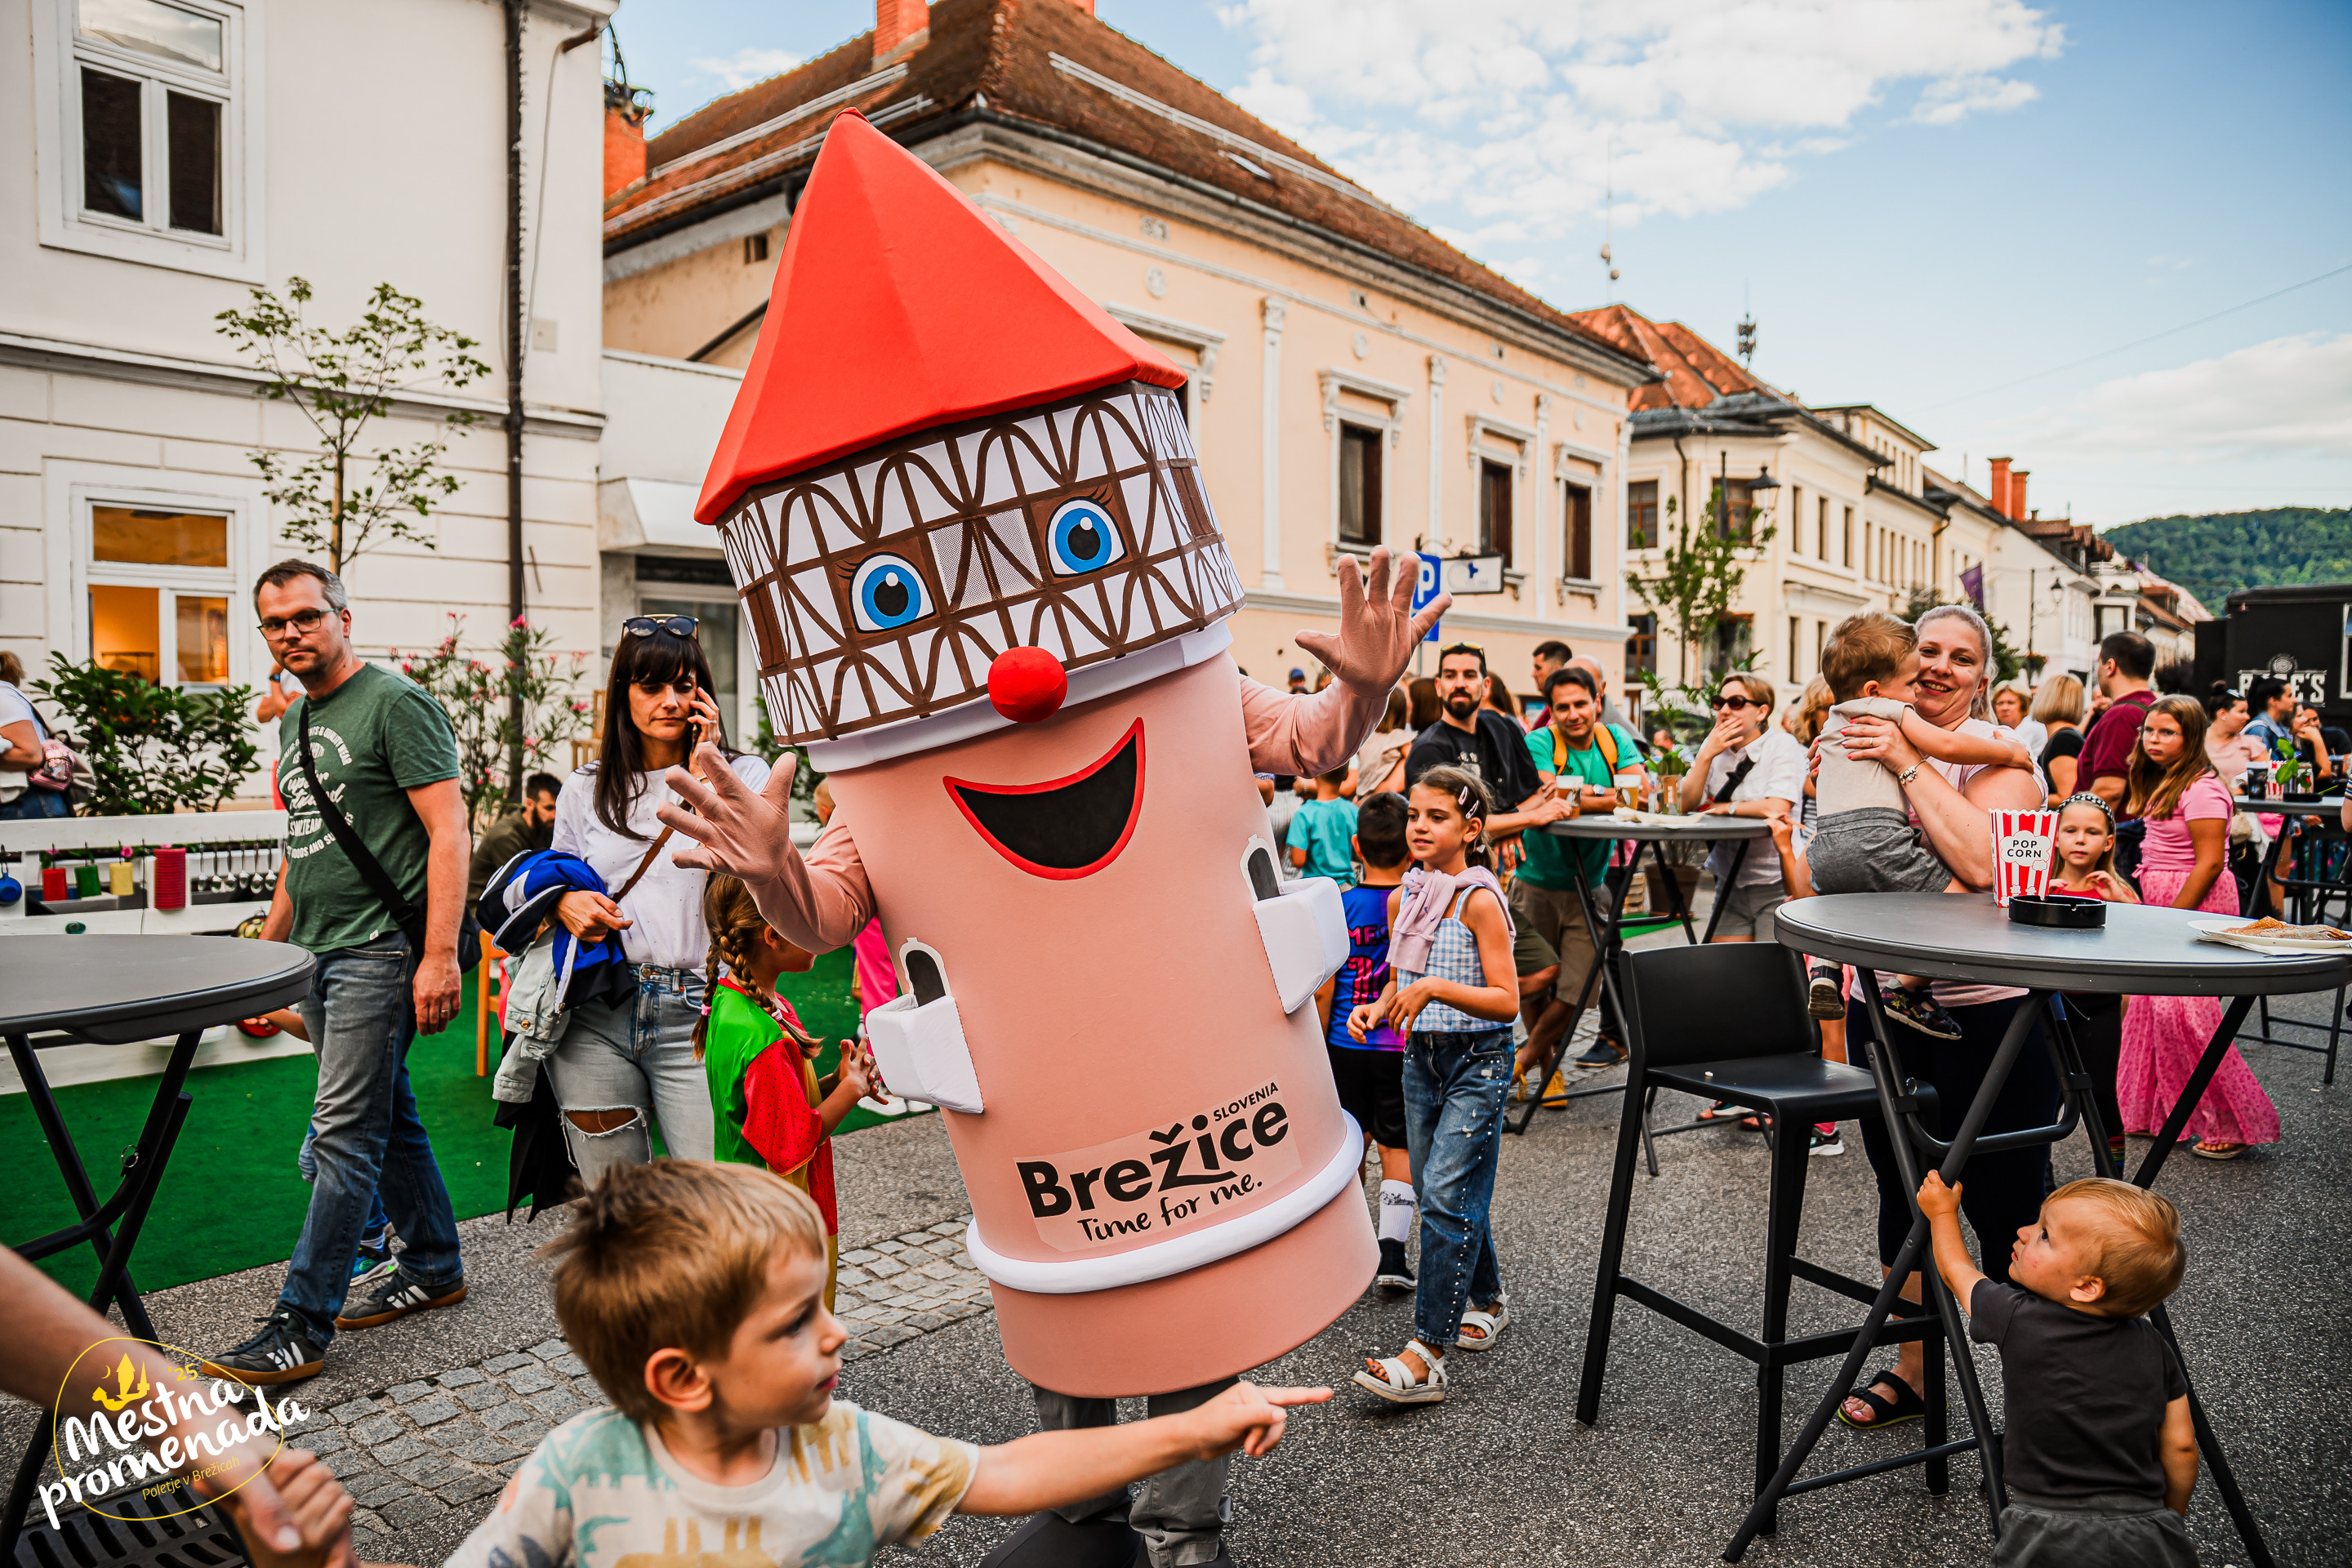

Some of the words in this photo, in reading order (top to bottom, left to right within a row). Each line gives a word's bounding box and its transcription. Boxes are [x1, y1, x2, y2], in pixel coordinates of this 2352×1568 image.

[1418, 561, 1435, 603] P
[309, 839, 325, 854] AND
[2007, 849, 2042, 858] CORN
[2013, 840, 2037, 848] POP
[1214, 1081, 1279, 1122] SLOVENIA
[1016, 1101, 1289, 1218] Brežice
[1076, 1212, 1152, 1242] Time
[1160, 1196, 1200, 1227] for
[1209, 1173, 1263, 1205] me.
